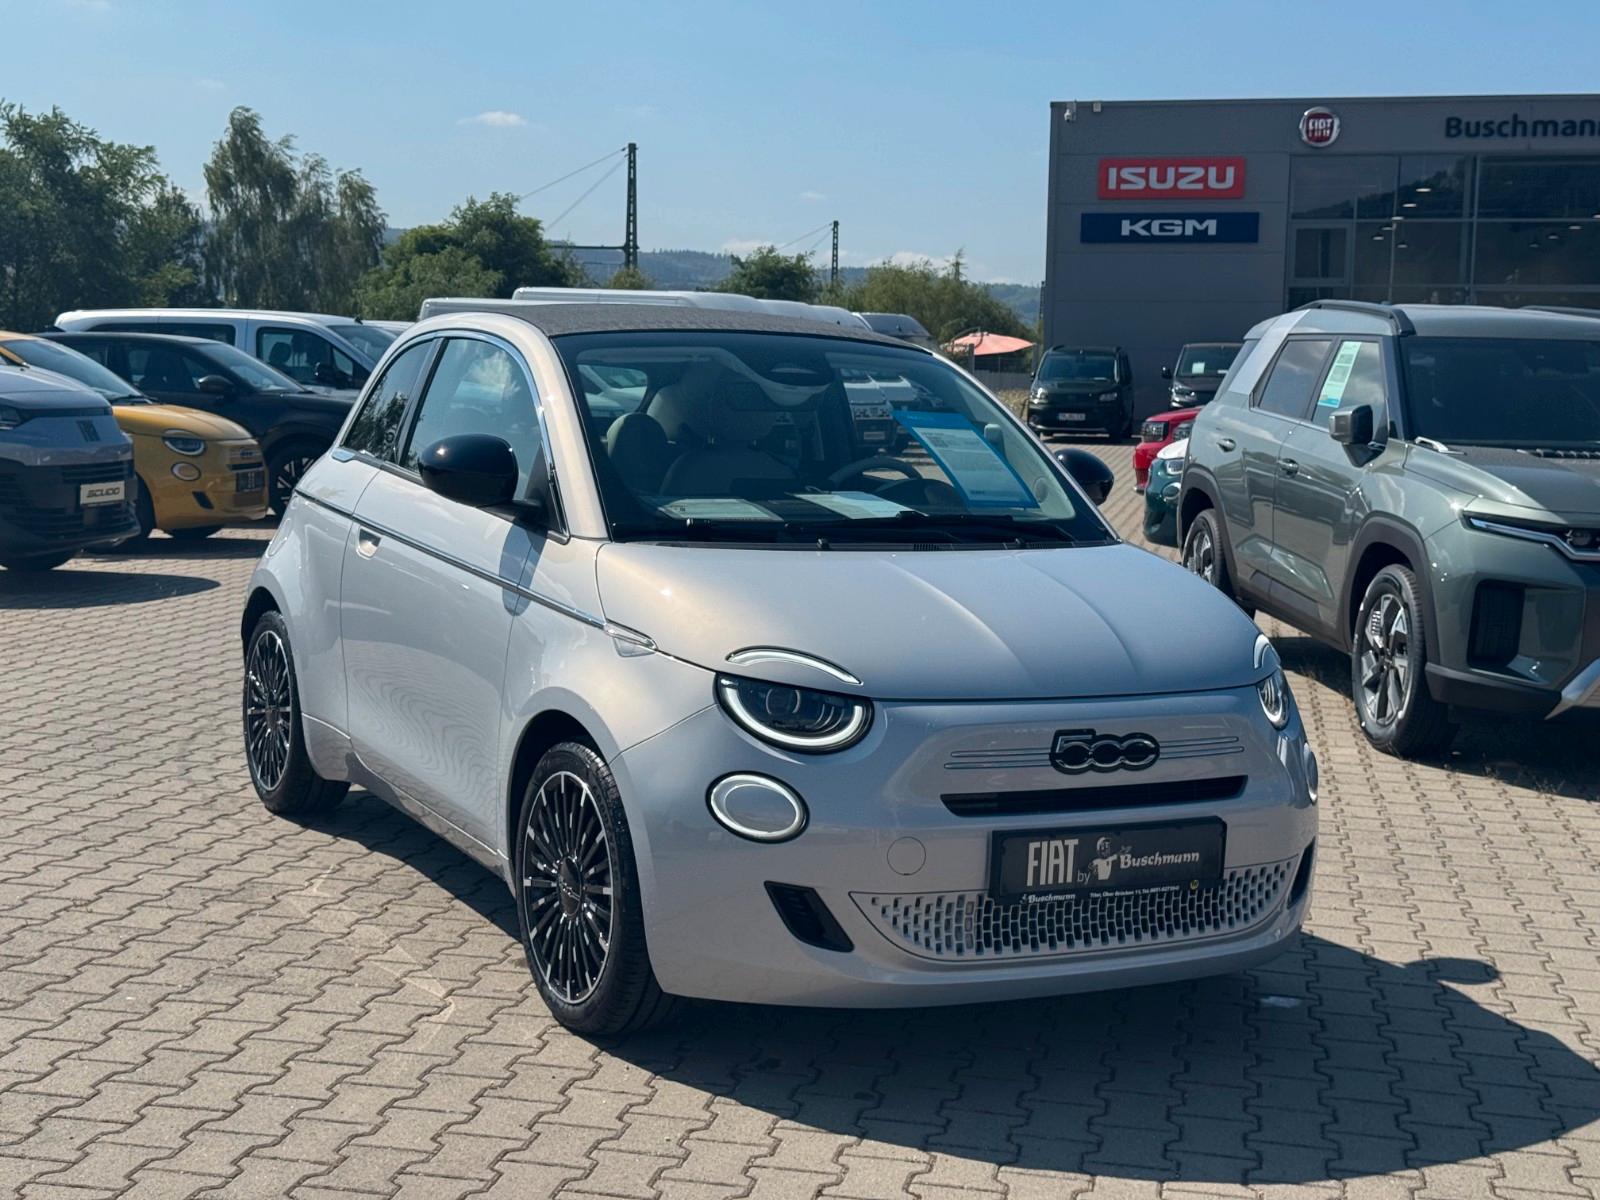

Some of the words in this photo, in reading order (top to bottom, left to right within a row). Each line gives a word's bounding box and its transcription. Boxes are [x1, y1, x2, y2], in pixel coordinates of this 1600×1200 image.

[1308, 118, 1333, 138] FIAT
[1444, 113, 1600, 138] Buschman
[1107, 165, 1236, 191] ISUZU
[1120, 217, 1218, 237] KGM
[1050, 729, 1160, 775] 500
[1026, 838, 1079, 887] FIAT
[1077, 869, 1091, 886] by
[1119, 850, 1200, 869] Buschmann
